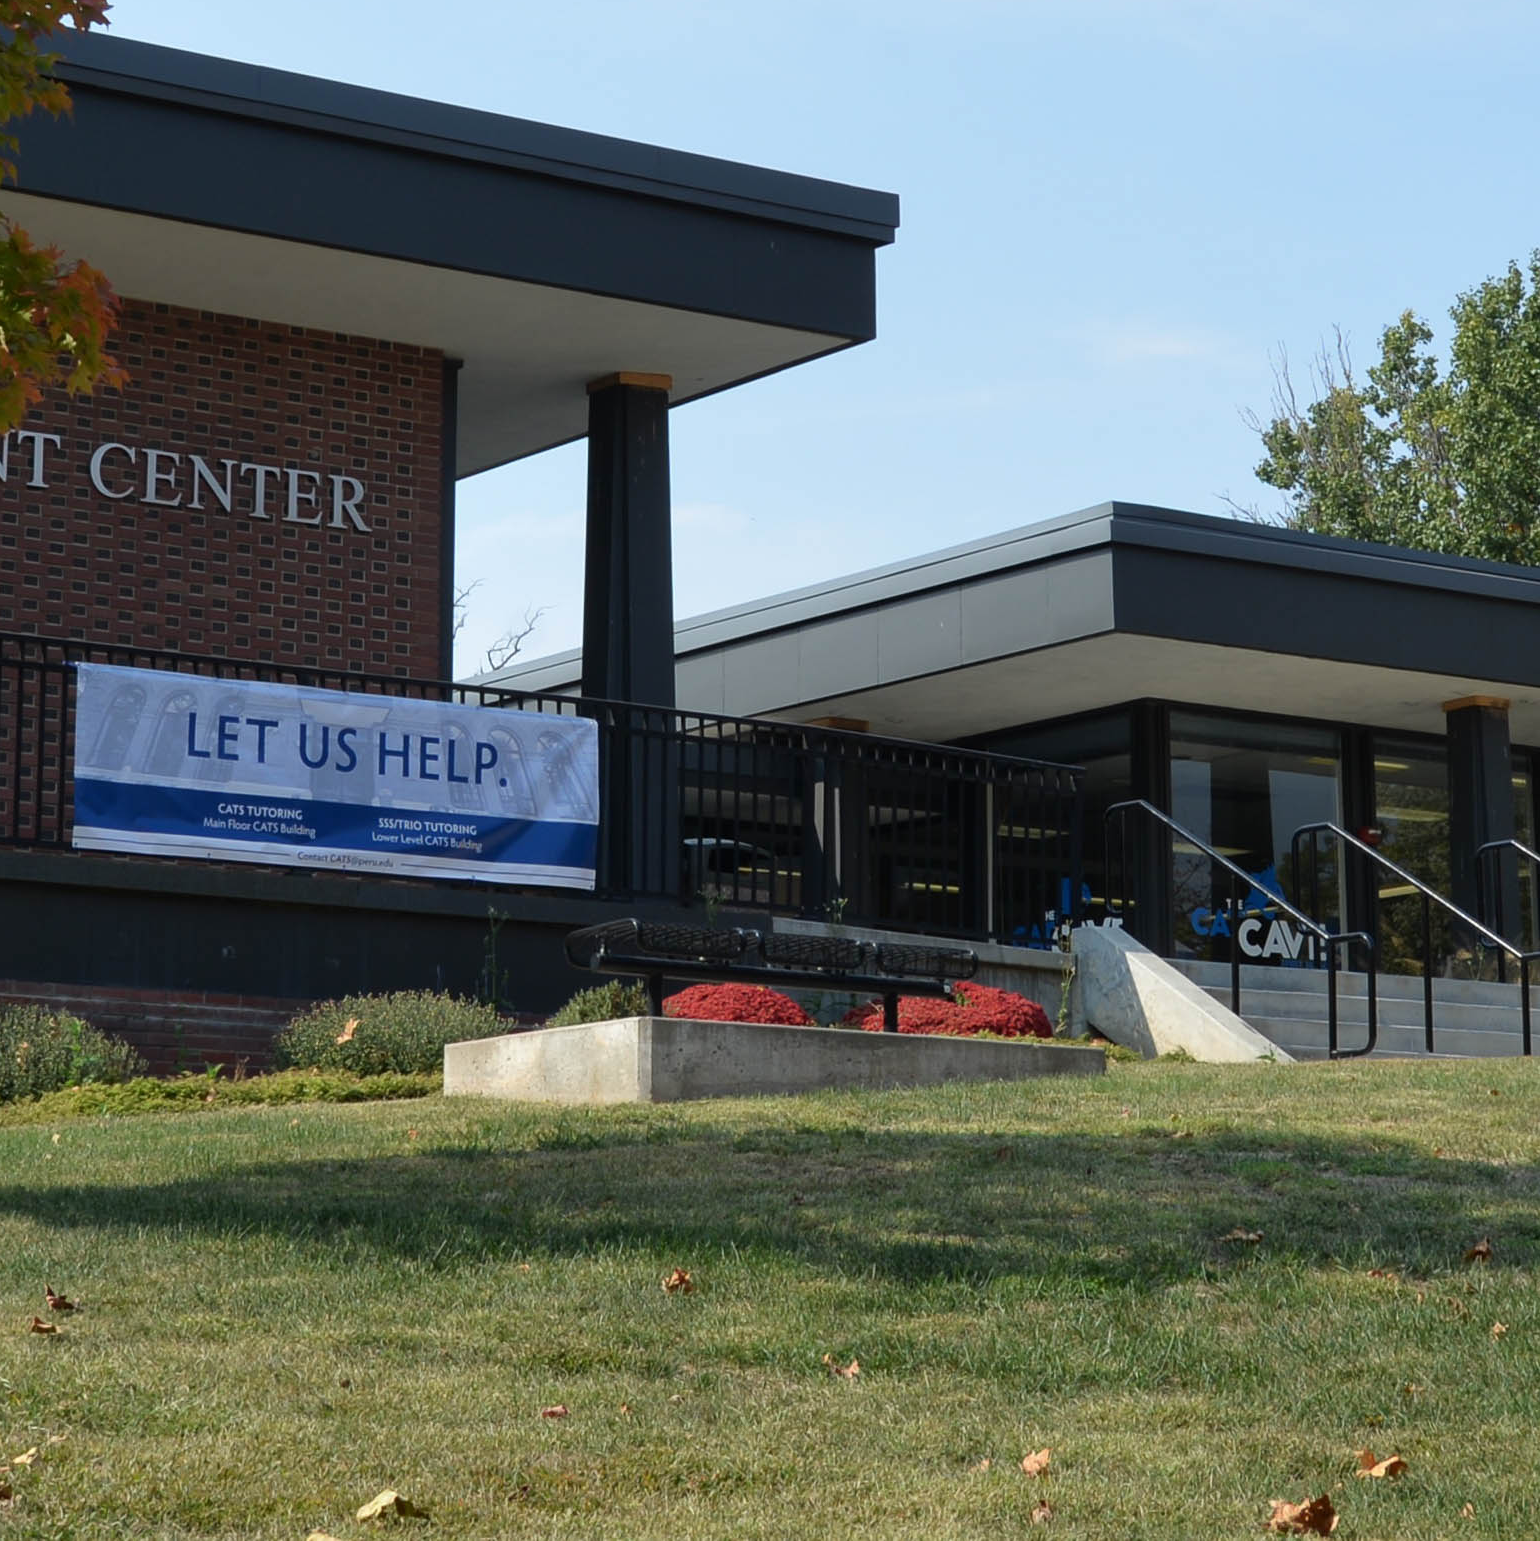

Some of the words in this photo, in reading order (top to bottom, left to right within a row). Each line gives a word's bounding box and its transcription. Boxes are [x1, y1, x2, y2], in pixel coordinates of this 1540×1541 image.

[89, 442, 372, 533] CENTER
[187, 712, 279, 764] LET
[299, 723, 357, 772] US
[378, 732, 508, 788] HELP.
[218, 803, 245, 816] CATS
[246, 805, 303, 820] TUTORING
[203, 817, 226, 829] Main
[228, 819, 251, 831] Floor
[252, 821, 279, 834] CATS
[281, 824, 316, 840] Building
[378, 817, 422, 831] SSS/TRIO
[424, 821, 477, 836] TUTORING
[372, 831, 399, 843] Lower
[401, 834, 423, 845] Level
[424, 836, 449, 848] CATS
[450, 838, 483, 854] Building
[297, 851, 328, 862] Contact
[1225, 898, 1243, 910] TE
